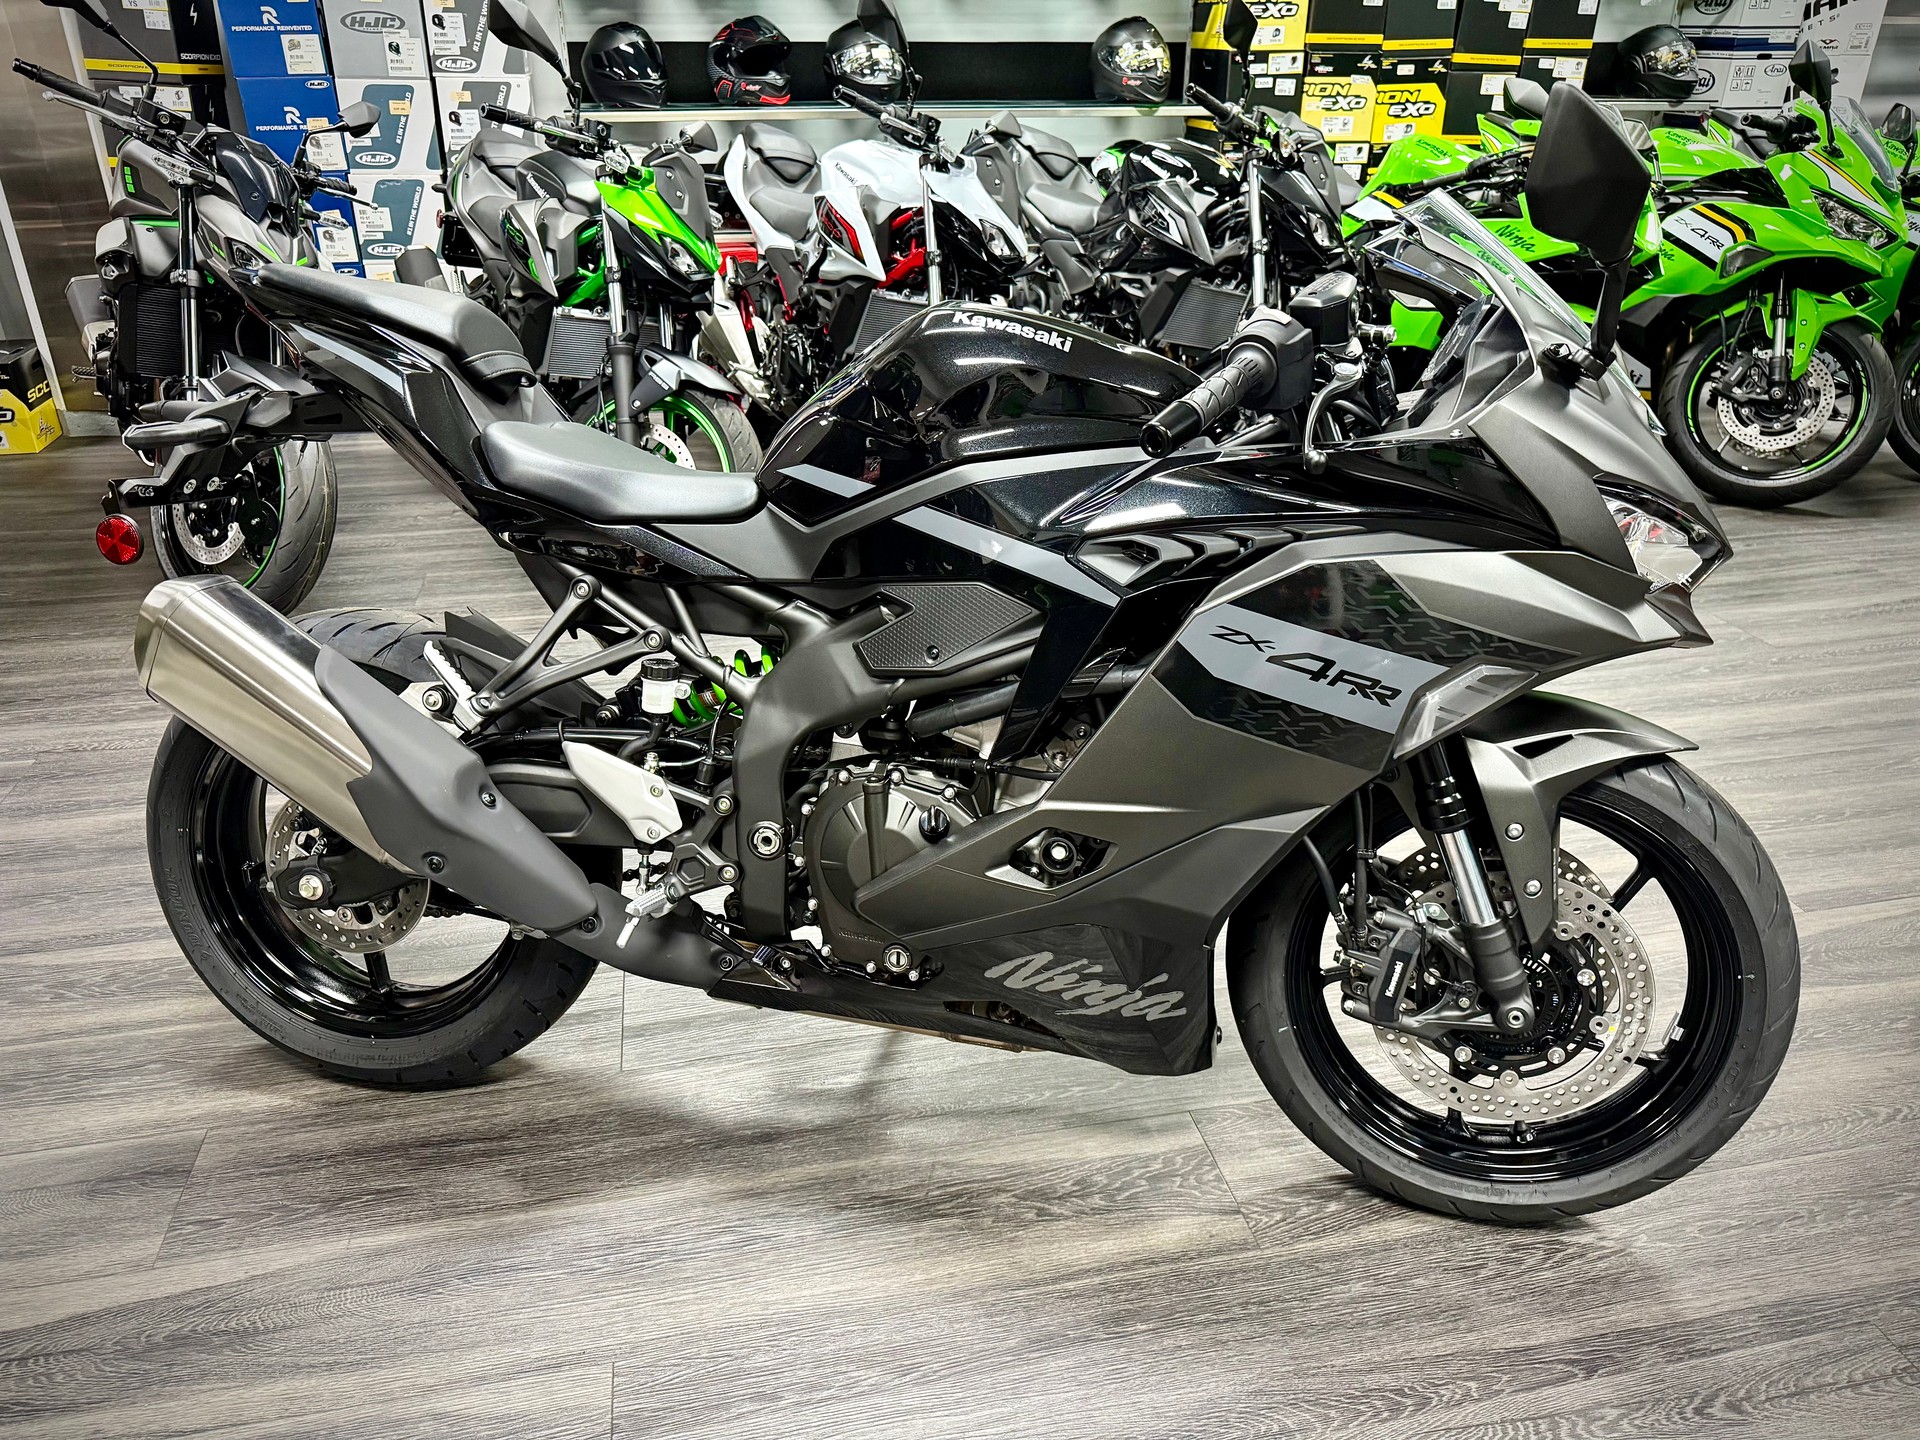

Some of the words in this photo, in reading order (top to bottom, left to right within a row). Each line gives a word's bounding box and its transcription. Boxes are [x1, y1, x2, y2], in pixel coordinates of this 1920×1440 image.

[350, 16, 396, 28] HJC
[441, 60, 471, 68] HJC
[1320, 96, 1367, 110] EXO
[1388, 103, 1436, 117] EXO
[526, 172, 550, 198] Kawasaki
[834, 162, 858, 185] Kawasaki
[1494, 224, 1535, 253] Ninja
[952, 311, 1073, 353] Kawasaki
[1209, 625, 1402, 708] ZX-4RR
[984, 951, 1187, 1021] Ninja
[1384, 960, 1404, 998] Kawasaki
